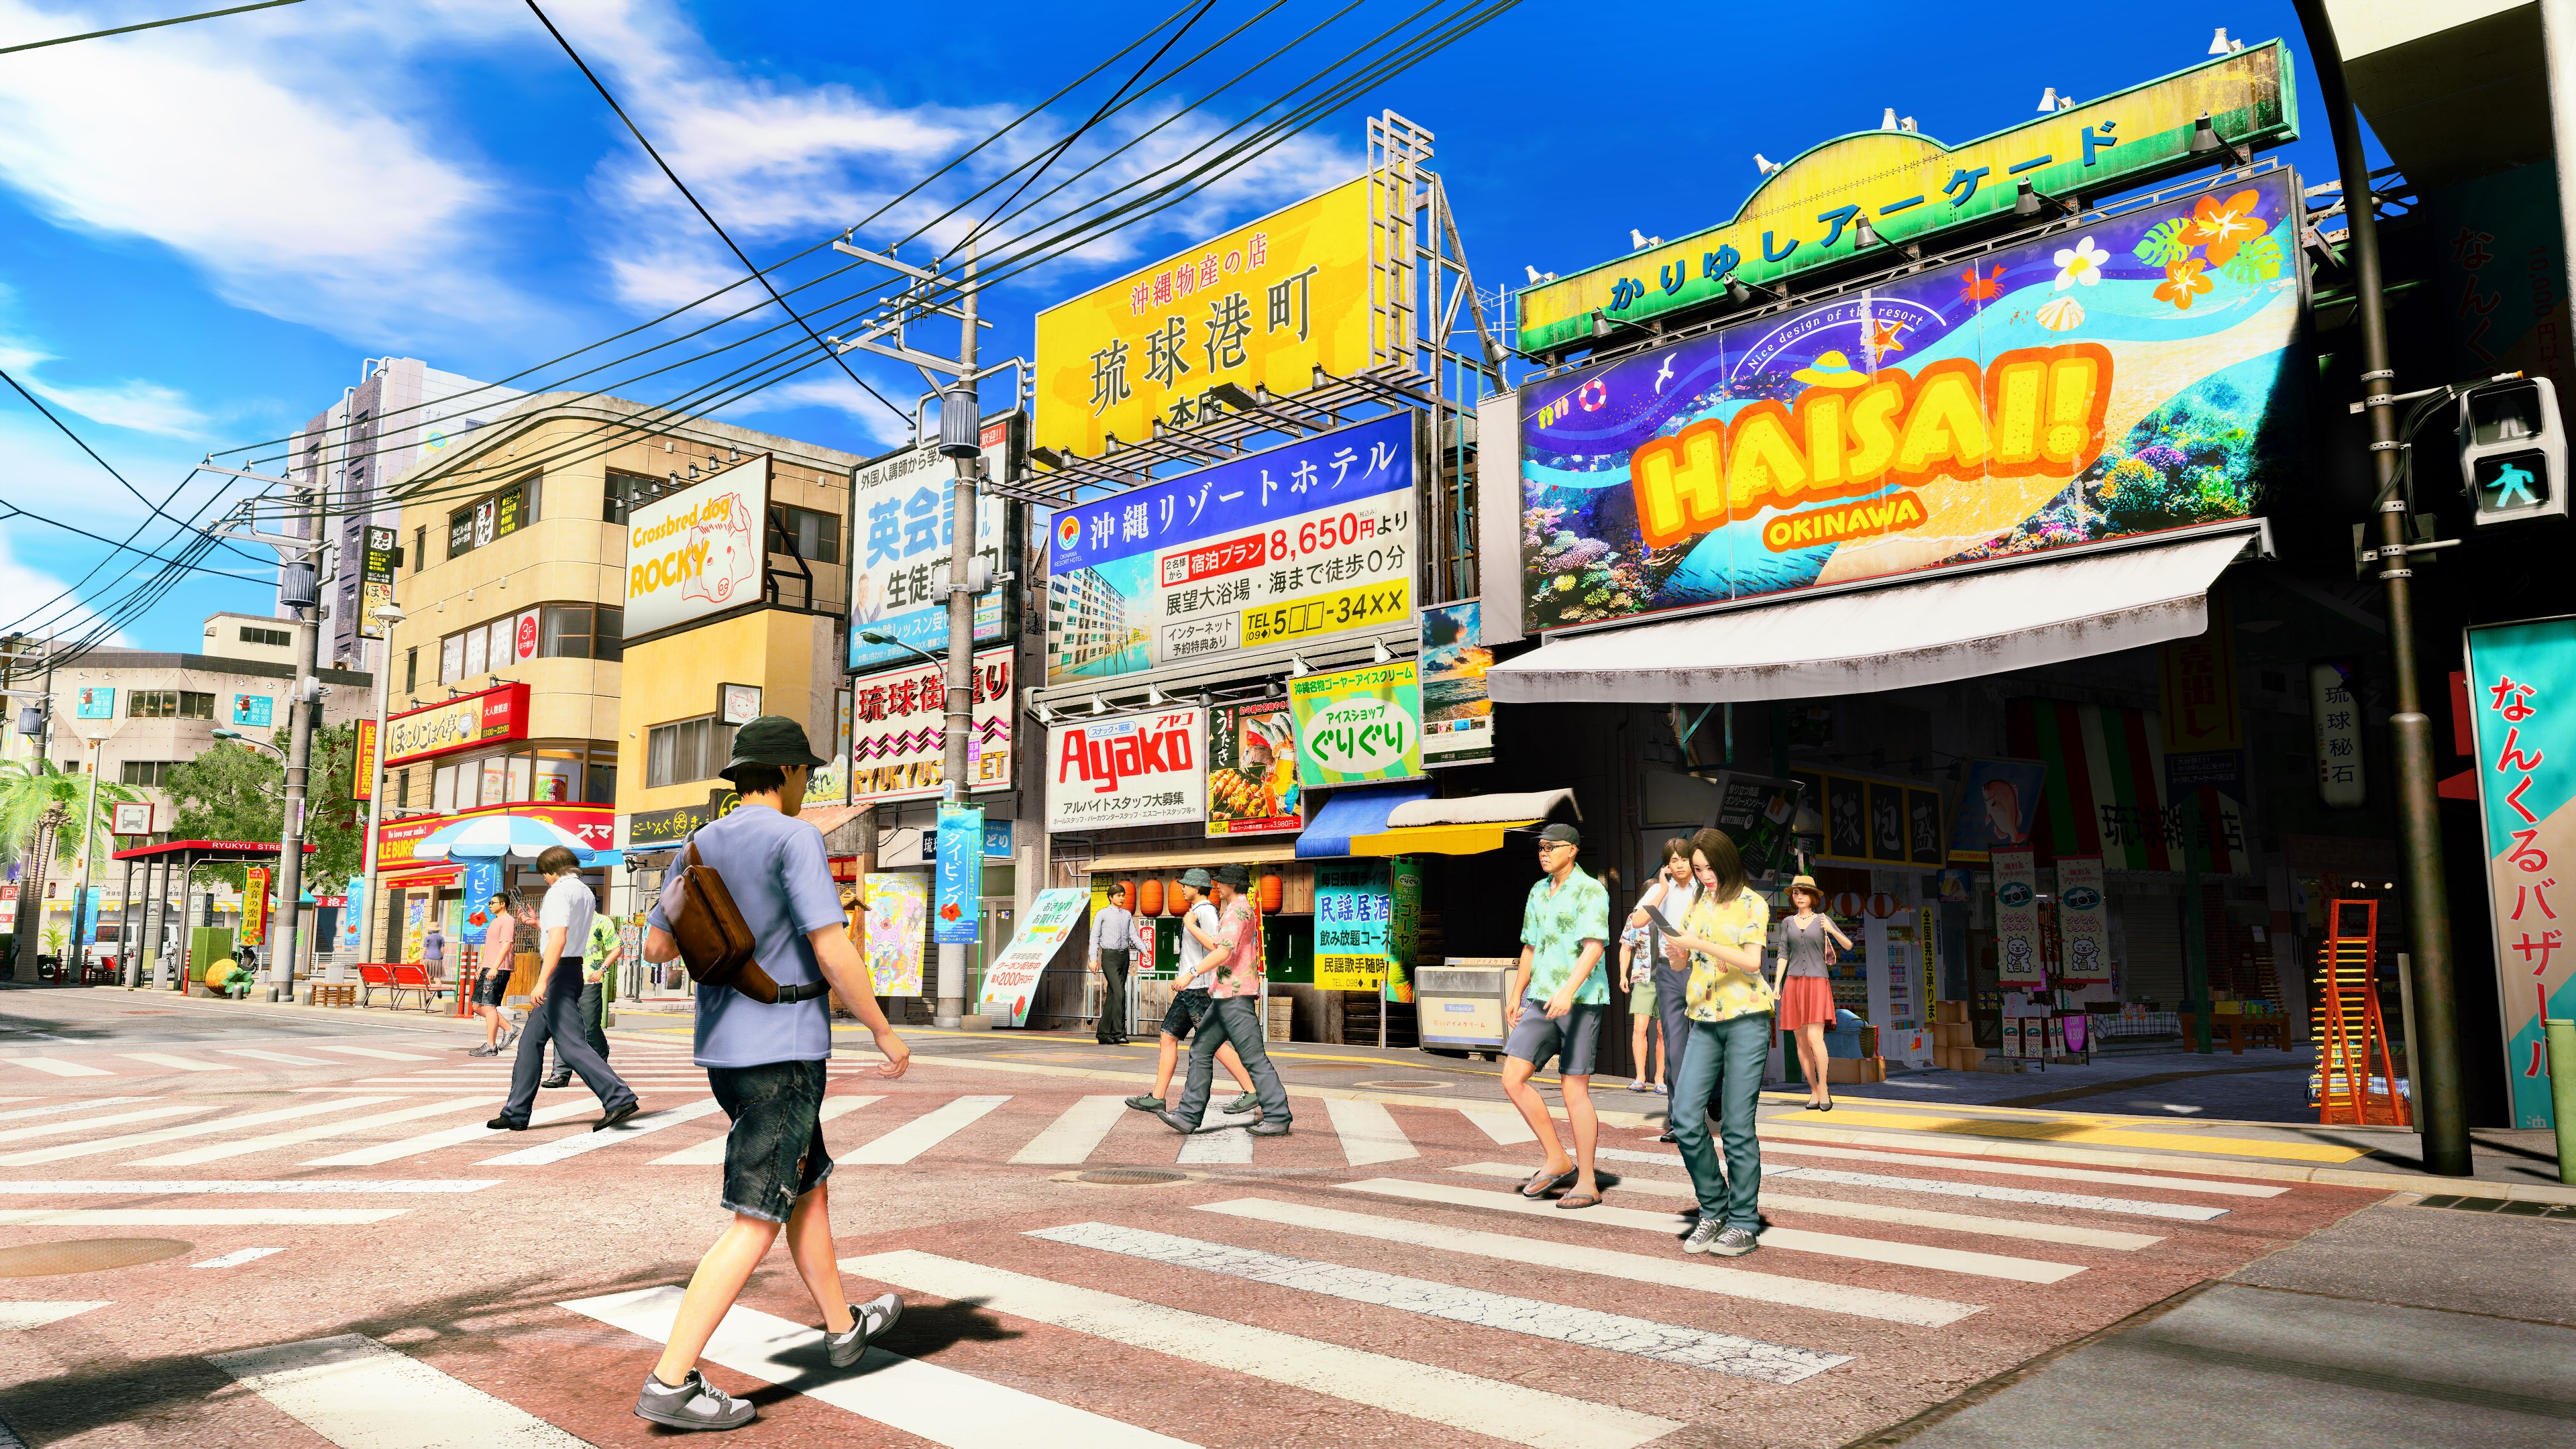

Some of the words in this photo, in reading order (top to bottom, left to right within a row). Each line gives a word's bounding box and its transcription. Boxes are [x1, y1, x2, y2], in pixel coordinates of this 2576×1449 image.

[1609, 121, 2118, 311] かりゆしアーケード
[1131, 232, 1269, 316] 沖縄物産の店
[1089, 264, 1318, 417] 琉球港町
[1748, 343, 1775, 370] Nice
[1778, 317, 1821, 345] design
[1826, 309, 1842, 322] of
[1849, 306, 1872, 319] the
[1878, 307, 1924, 326] resort
[981, 429, 1002, 445] 歓迎!!
[1641, 357, 2098, 537] HAISAI!
[1090, 441, 1399, 550] 沖縄リゾートホテル
[633, 504, 698, 549] Crossbred
[702, 498, 730, 521] dog
[1769, 498, 1921, 546] OKINAWA
[629, 540, 710, 598] ROCKY
[1055, 559, 1069, 567] RESORT
[1191, 541, 1263, 574] 宿泊プラン
[1168, 570, 1182, 580] から
[522, 623, 533, 640] 3F
[1169, 619, 1232, 641] インターネット
[1248, 612, 1270, 629] TEL
[1173, 635, 1227, 656] 予約特典あり
[1294, 667, 1413, 696] 沖縄名物ゴーヤーアイスクリーム
[1092, 723, 1130, 736] スナック・喫茶
[1155, 713, 1193, 729] アヤコ
[1326, 706, 1385, 725] アイスショップ
[364, 725, 376, 755] SMILE
[1312, 721, 1402, 761] ぐりぐり
[2325, 687, 2355, 783] 琉球秘石
[360, 755, 374, 795] BURGER
[1059, 727, 1193, 794] Ayako
[1063, 792, 1185, 814] アルバイトスタッフ大募集
[388, 830, 393, 839] We
[402, 828, 413, 837] your
[986, 833, 1009, 848] どり
[378, 842, 391, 859] ILE
[943, 830, 965, 909] ダイビング
[247, 880, 261, 927] 波音の楽園
[471, 863, 490, 916] イビング
[350, 888, 360, 928] ダイビング
[1032, 914, 1069, 924] お買いモノ
[1043, 902, 1073, 912] おきなわ
[1320, 893, 1390, 923] 民謡居酒
[1410, 906, 1420, 962] アイスクリーム
[1923, 910, 1935, 1021] 全国発送承りま
